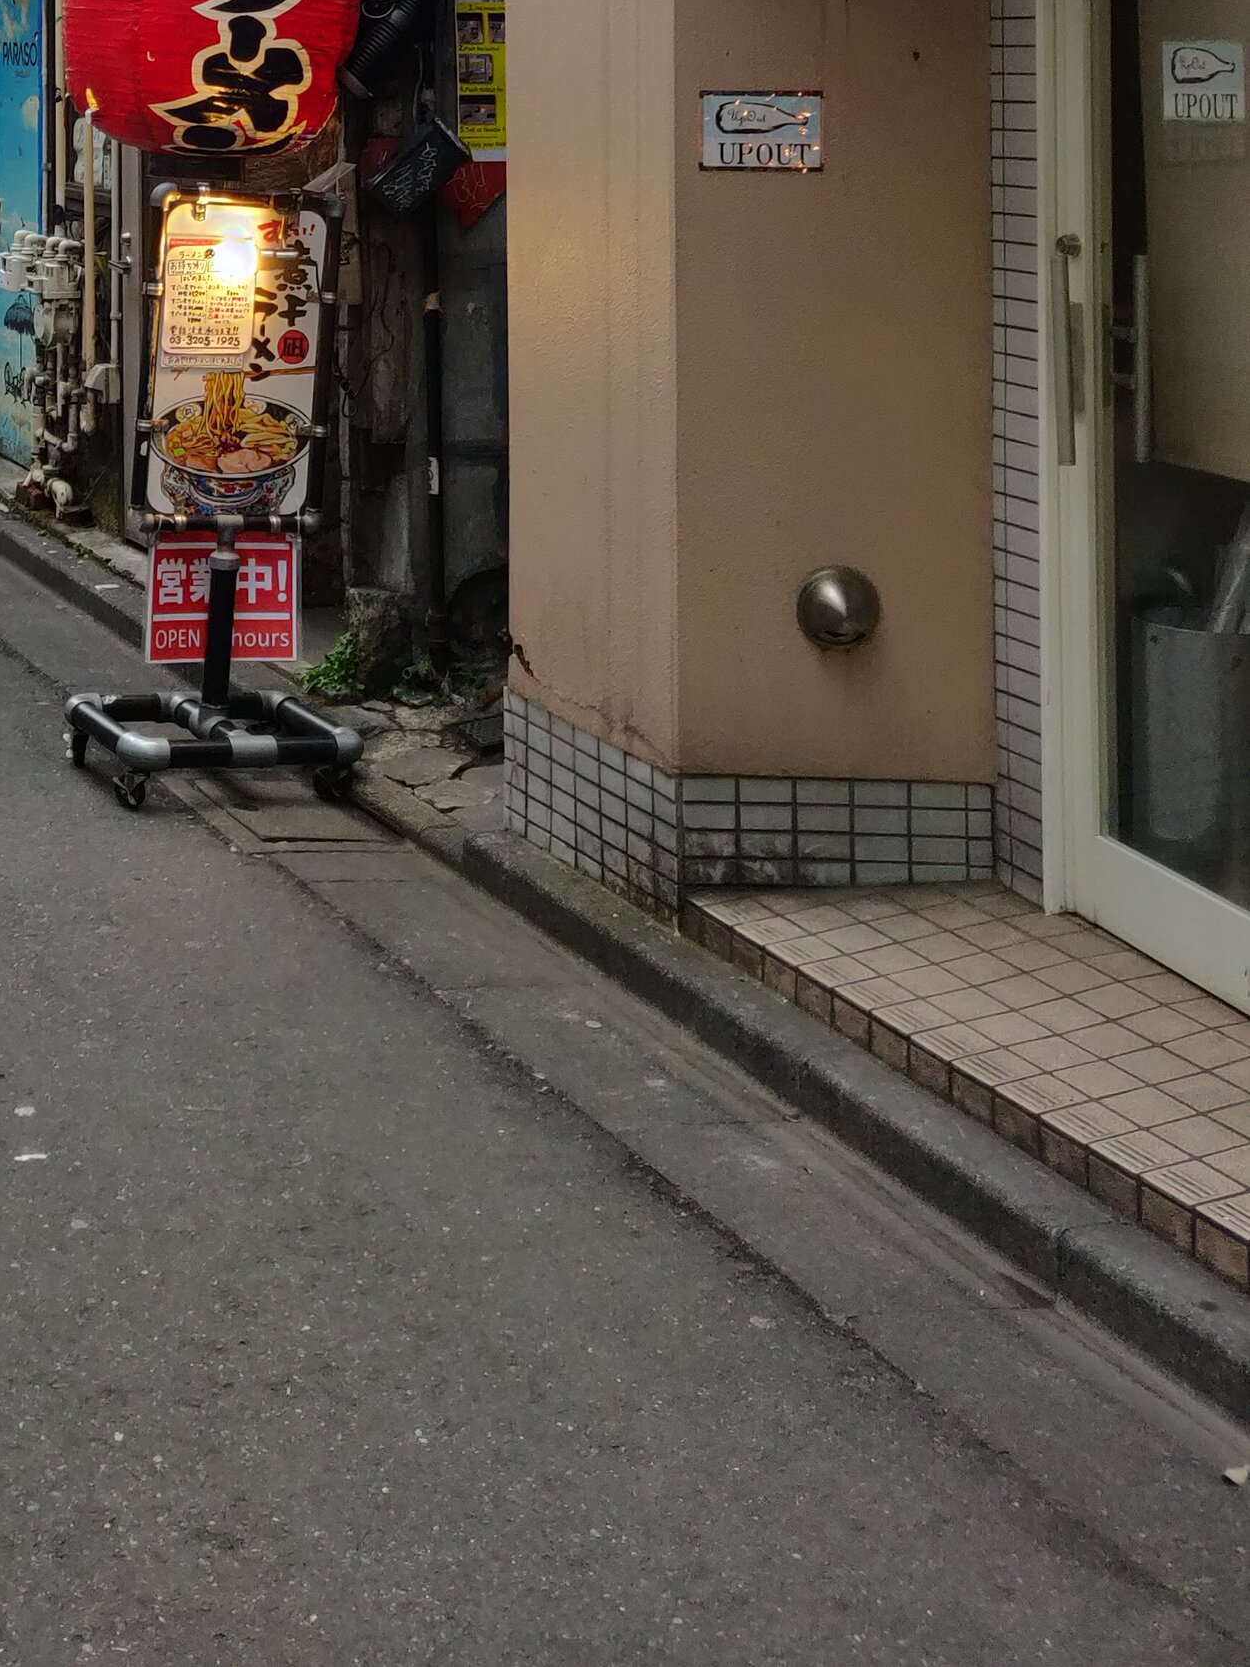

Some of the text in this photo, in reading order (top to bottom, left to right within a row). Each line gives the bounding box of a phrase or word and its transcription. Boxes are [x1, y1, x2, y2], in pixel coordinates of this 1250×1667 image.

[1173, 93, 1238, 119] UPOUT
[718, 142, 811, 165] UPOUT
[169, 335, 241, 347] 03-3205-1925
[155, 628, 200, 649] OPEN
